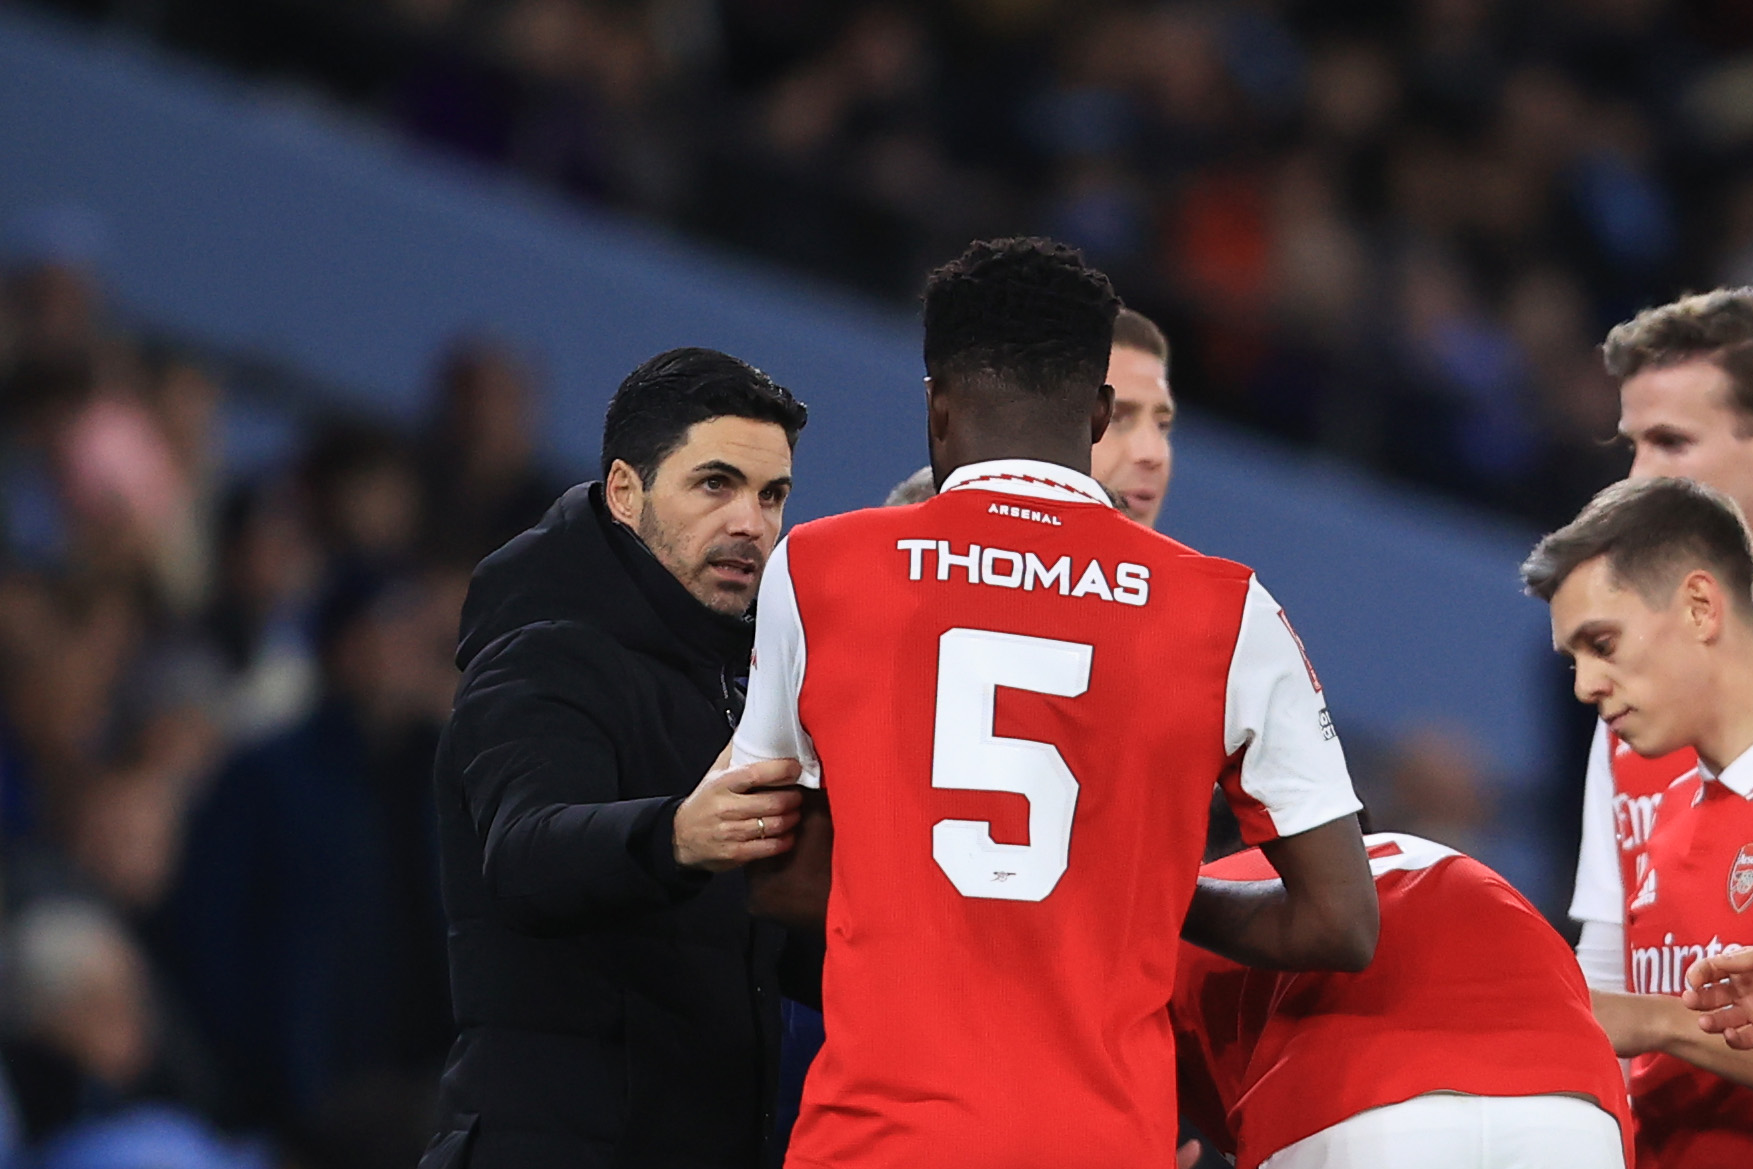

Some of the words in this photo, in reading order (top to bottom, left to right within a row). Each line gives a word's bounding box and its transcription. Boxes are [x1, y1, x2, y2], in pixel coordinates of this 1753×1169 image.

[988, 503, 1062, 525] ARSENAL
[897, 539, 1150, 606] THOMAS
[931, 627, 1094, 902] 5
